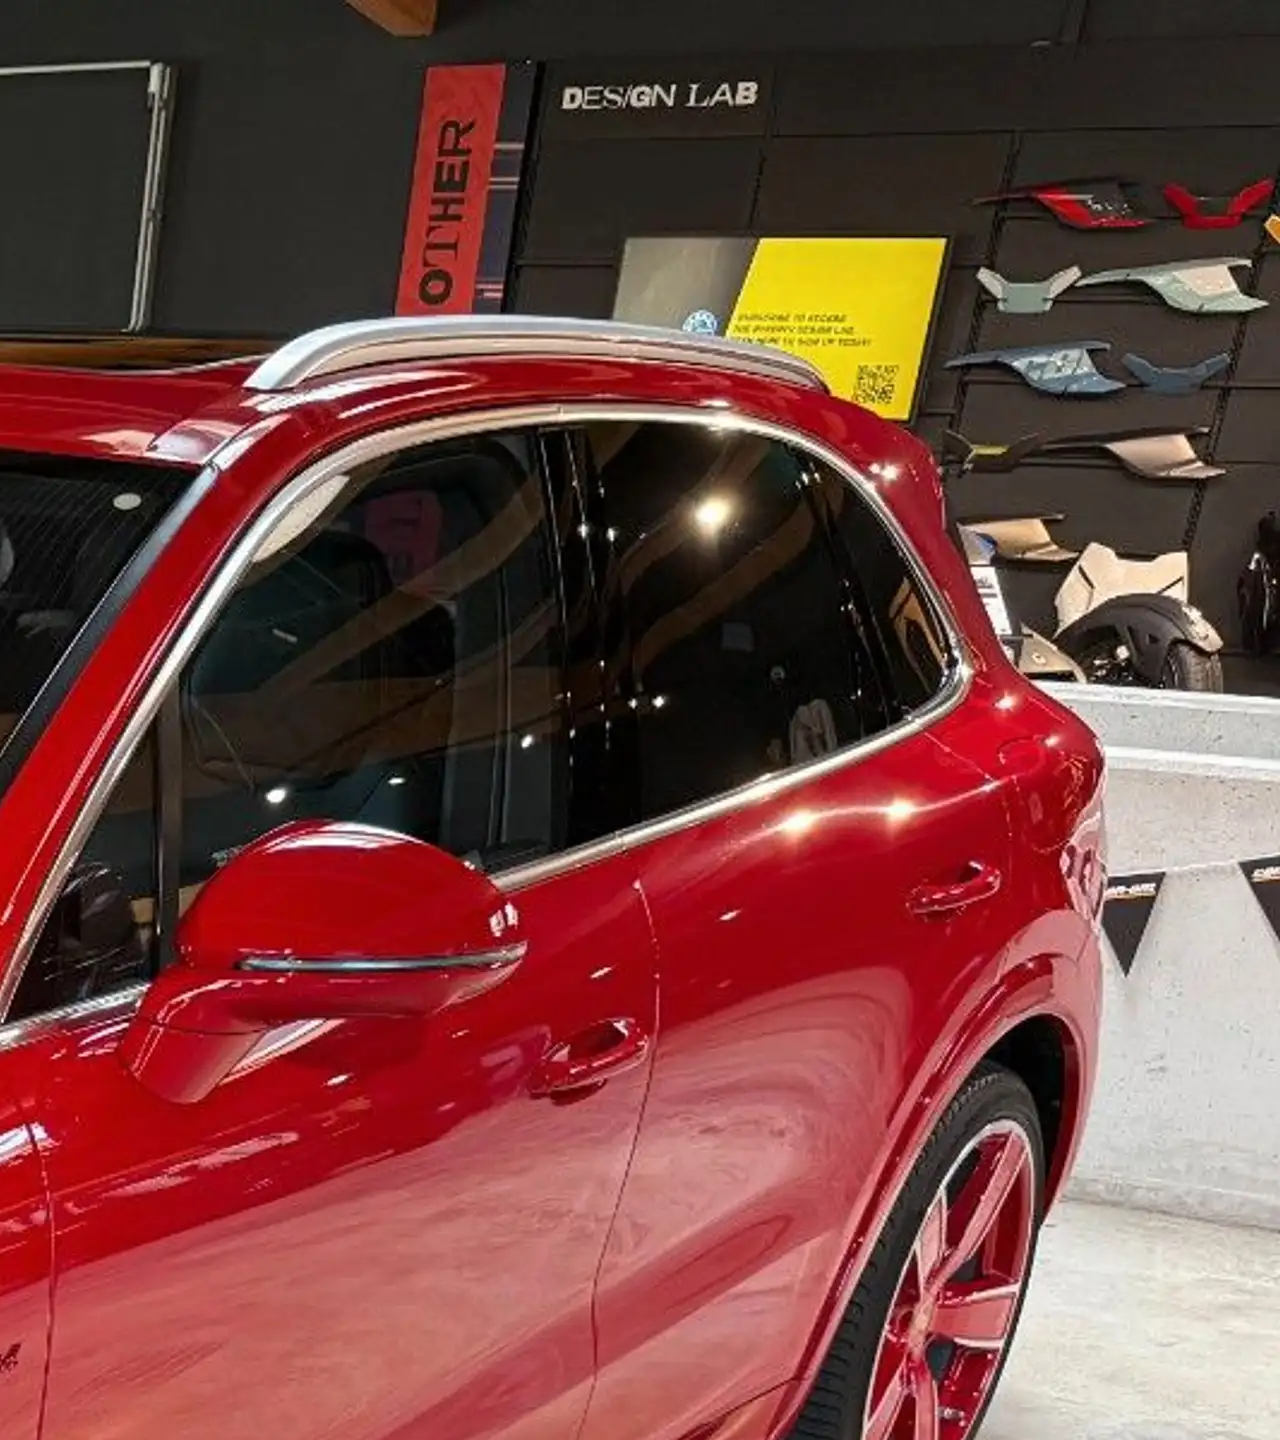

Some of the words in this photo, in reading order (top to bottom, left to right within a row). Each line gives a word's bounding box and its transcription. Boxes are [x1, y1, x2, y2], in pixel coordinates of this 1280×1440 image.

[562, 84, 676, 110] DESIGN
[686, 81, 759, 107] LAB
[419, 119, 476, 306] OTHER
